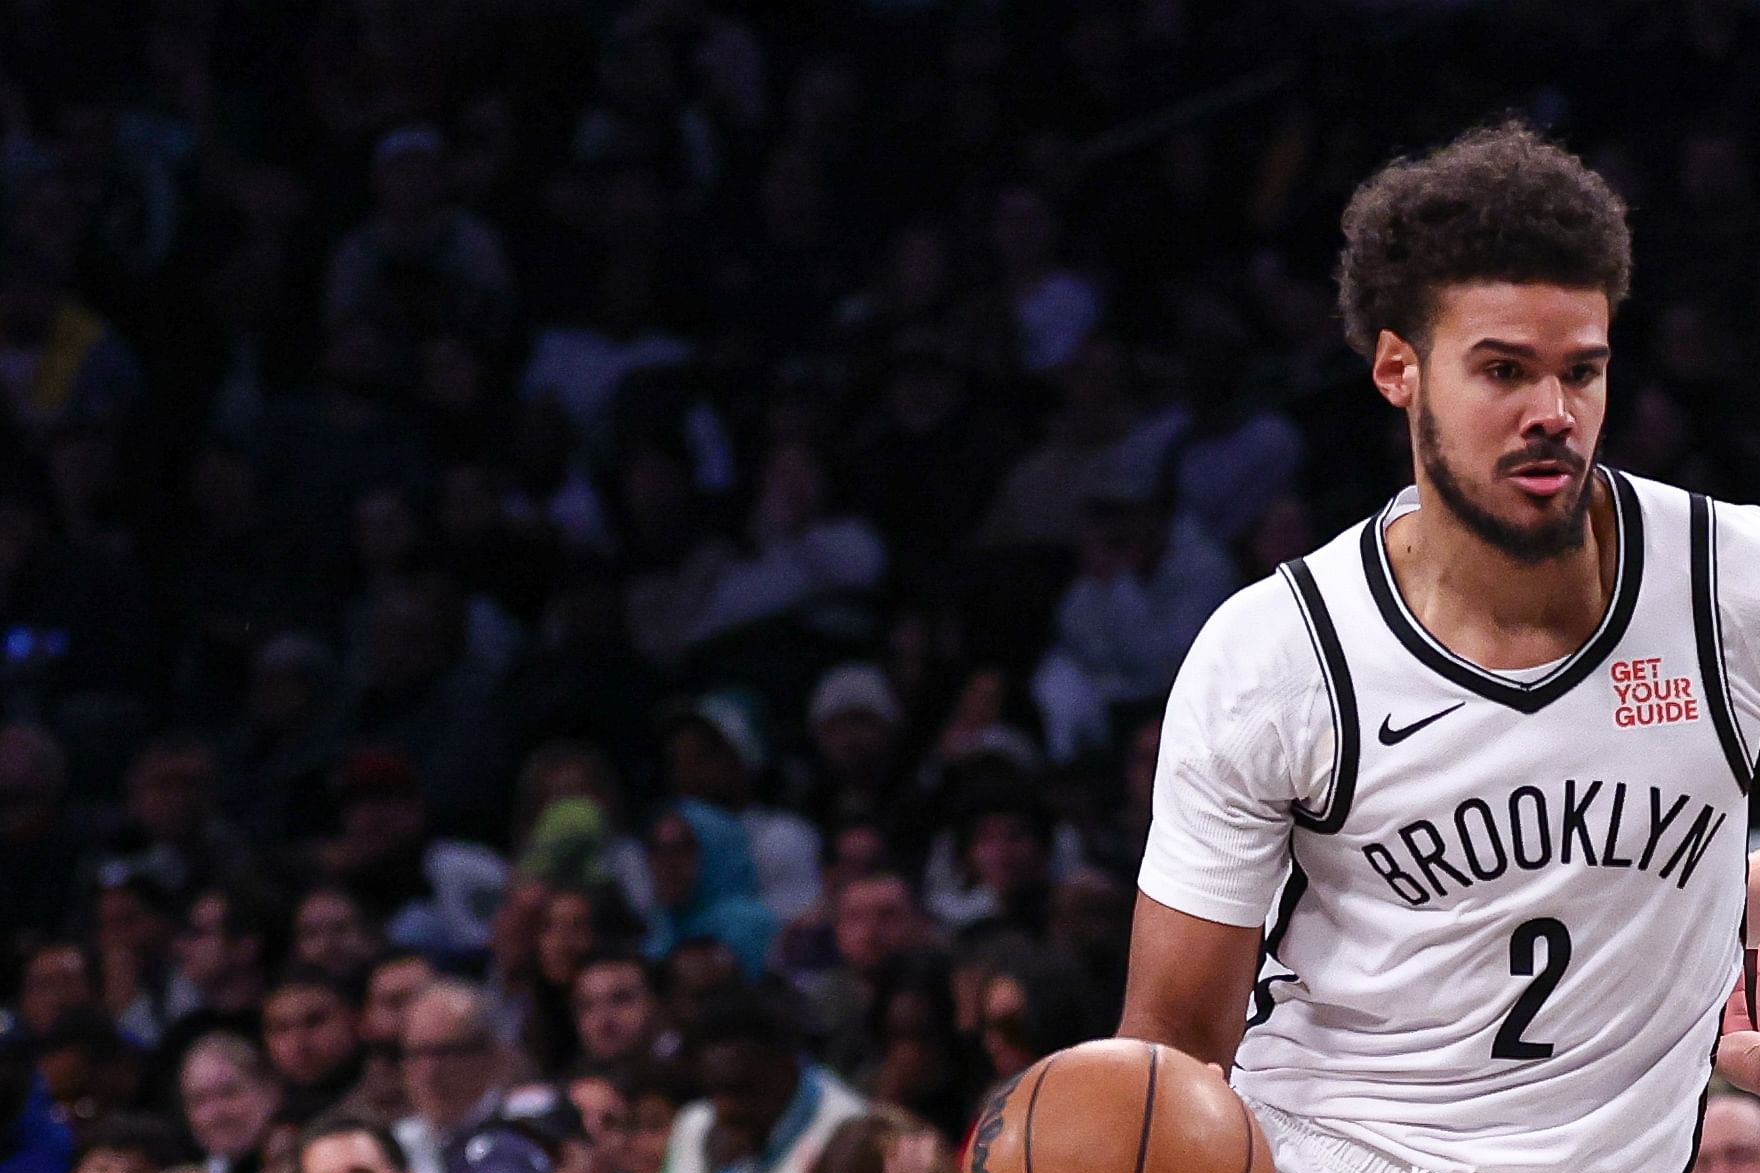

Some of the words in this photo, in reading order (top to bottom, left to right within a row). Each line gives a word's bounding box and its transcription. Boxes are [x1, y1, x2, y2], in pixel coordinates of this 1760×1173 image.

[1611, 658, 1662, 683] GET
[1614, 677, 1691, 705] YOUR
[1615, 699, 1698, 727] GUIDE
[1361, 779, 1727, 905] BROOKLYN
[1491, 916, 1572, 1060] 2
